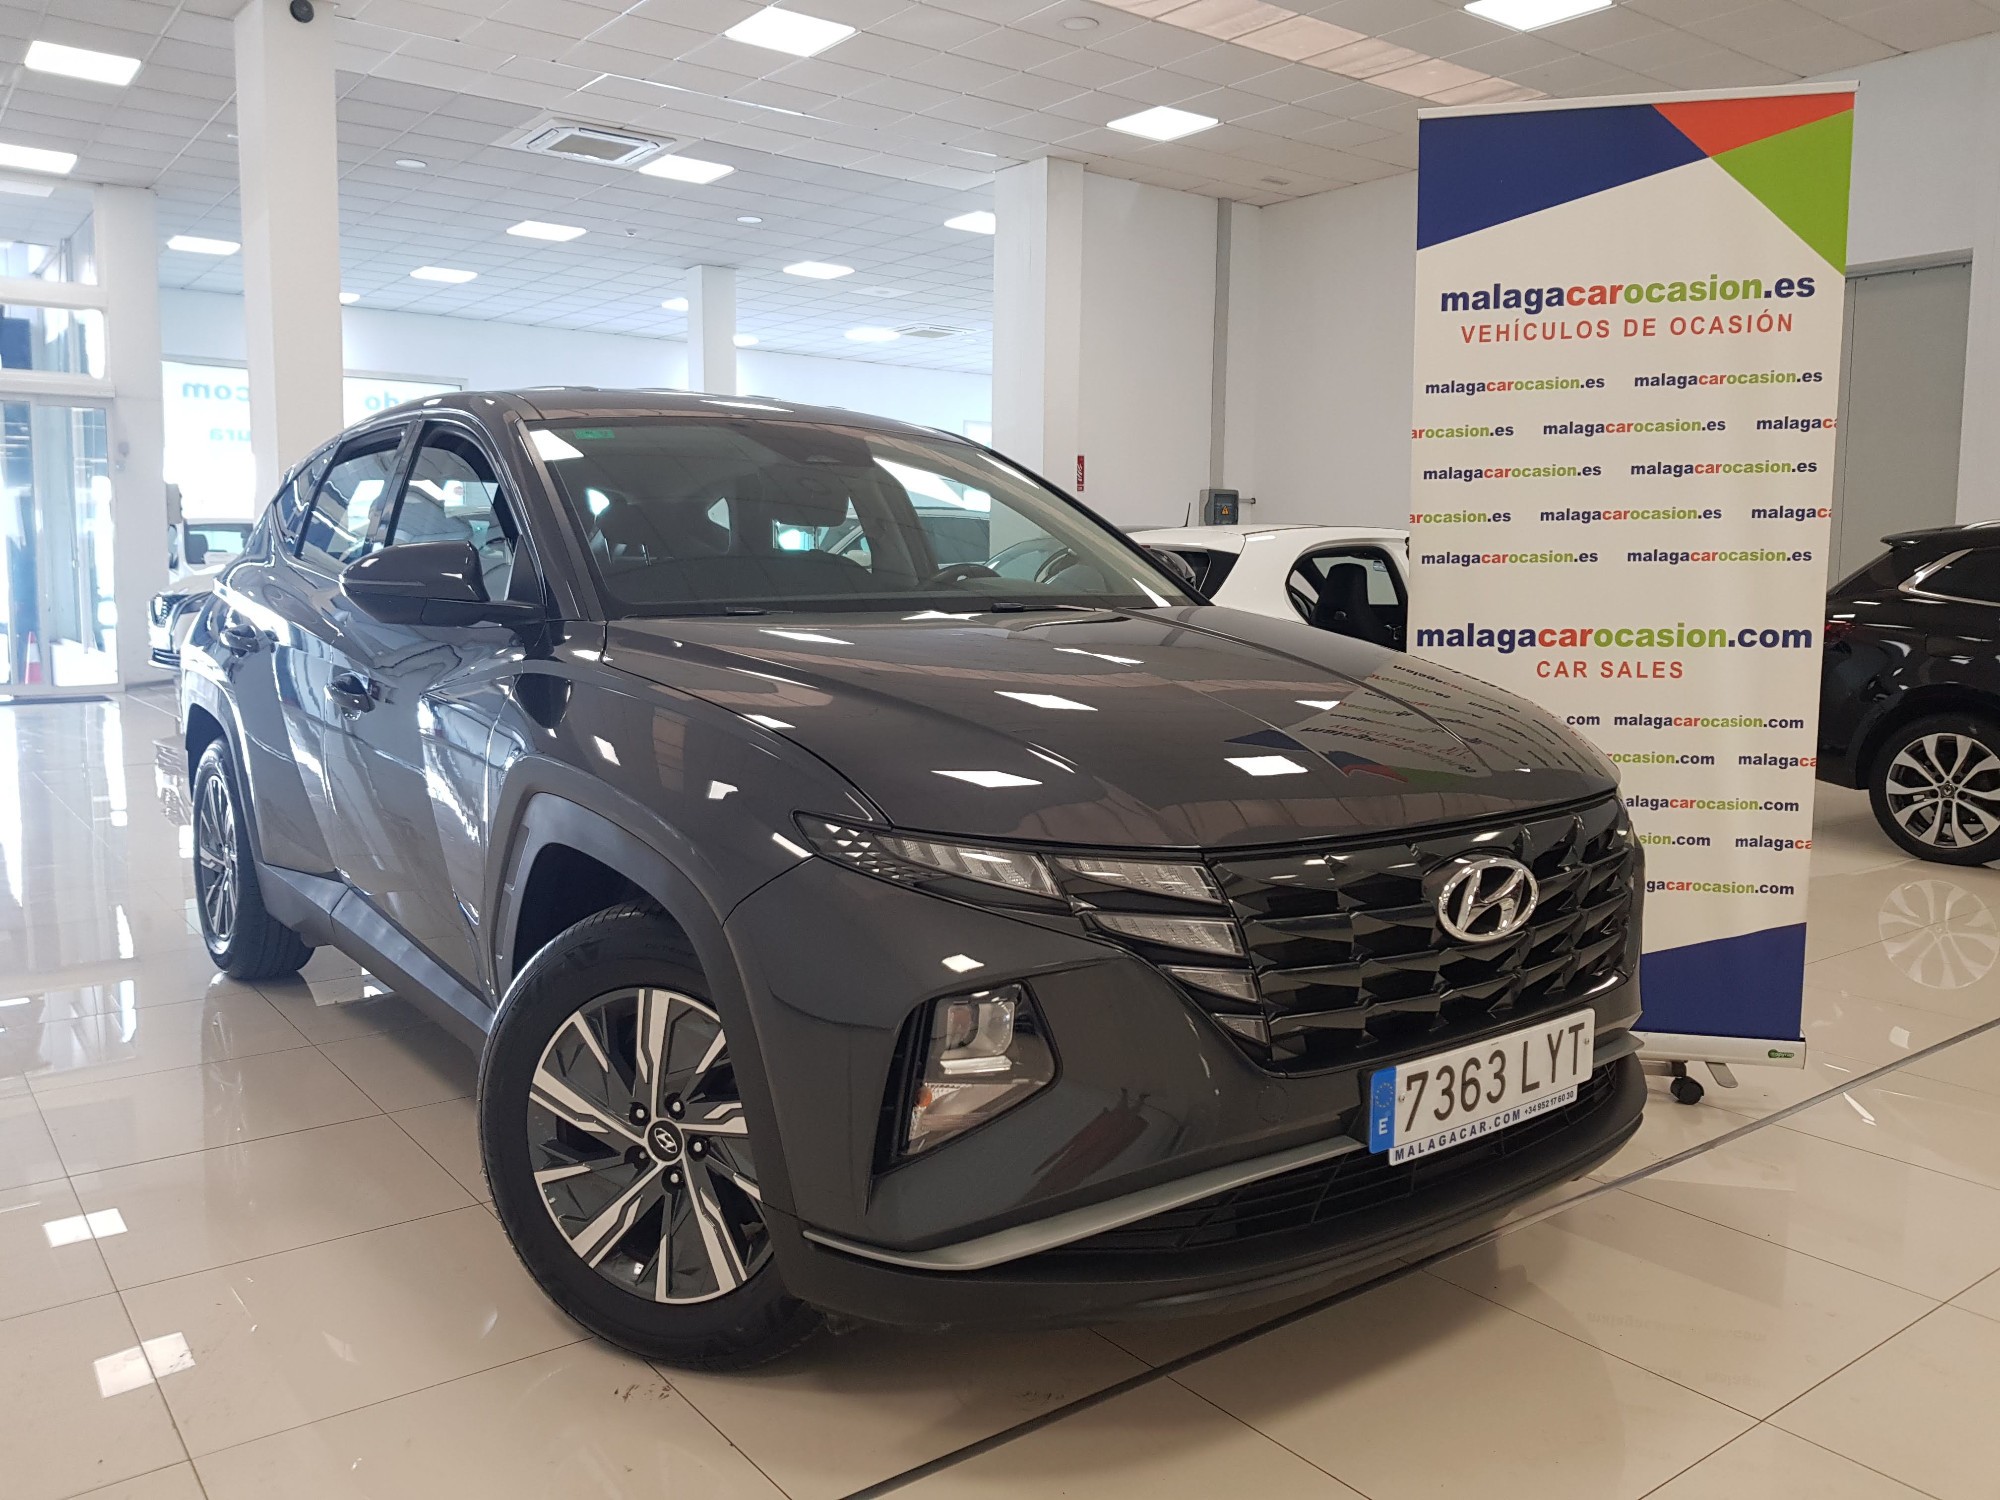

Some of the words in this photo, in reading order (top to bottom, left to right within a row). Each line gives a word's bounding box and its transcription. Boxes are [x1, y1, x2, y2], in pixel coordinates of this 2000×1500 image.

[1441, 274, 1815, 314] malagacarocasion.es
[1462, 319, 1609, 343] VEHÍCULOS
[1624, 319, 1655, 336] DE
[1670, 309, 1791, 335] OCASIÓN
[1426, 377, 1604, 396] malagacarocasion.es
[1635, 370, 1822, 389] malagacarocasion.es
[1544, 419, 1725, 437] malagacarocasion.es
[1424, 464, 1601, 482] malagacarocasion.es
[1631, 460, 1817, 477] malagacarocasion.es
[1541, 507, 1721, 523] malagacarocasion.es
[1422, 551, 1598, 567] malagacarocasion.es
[1628, 549, 1812, 565] malagacarocasion.es
[1417, 623, 1812, 654] malagacarocasion.com
[1537, 661, 1587, 678] CAR
[1601, 661, 1682, 678] SALES
[1614, 714, 1803, 729] malagacarocasion.com
[1404, 1050, 1506, 1132] 7363
[1521, 1022, 1585, 1093] LYT
[1378, 1117, 1388, 1135] E
[1395, 1109, 1521, 1161] MALAGACAR.COM
